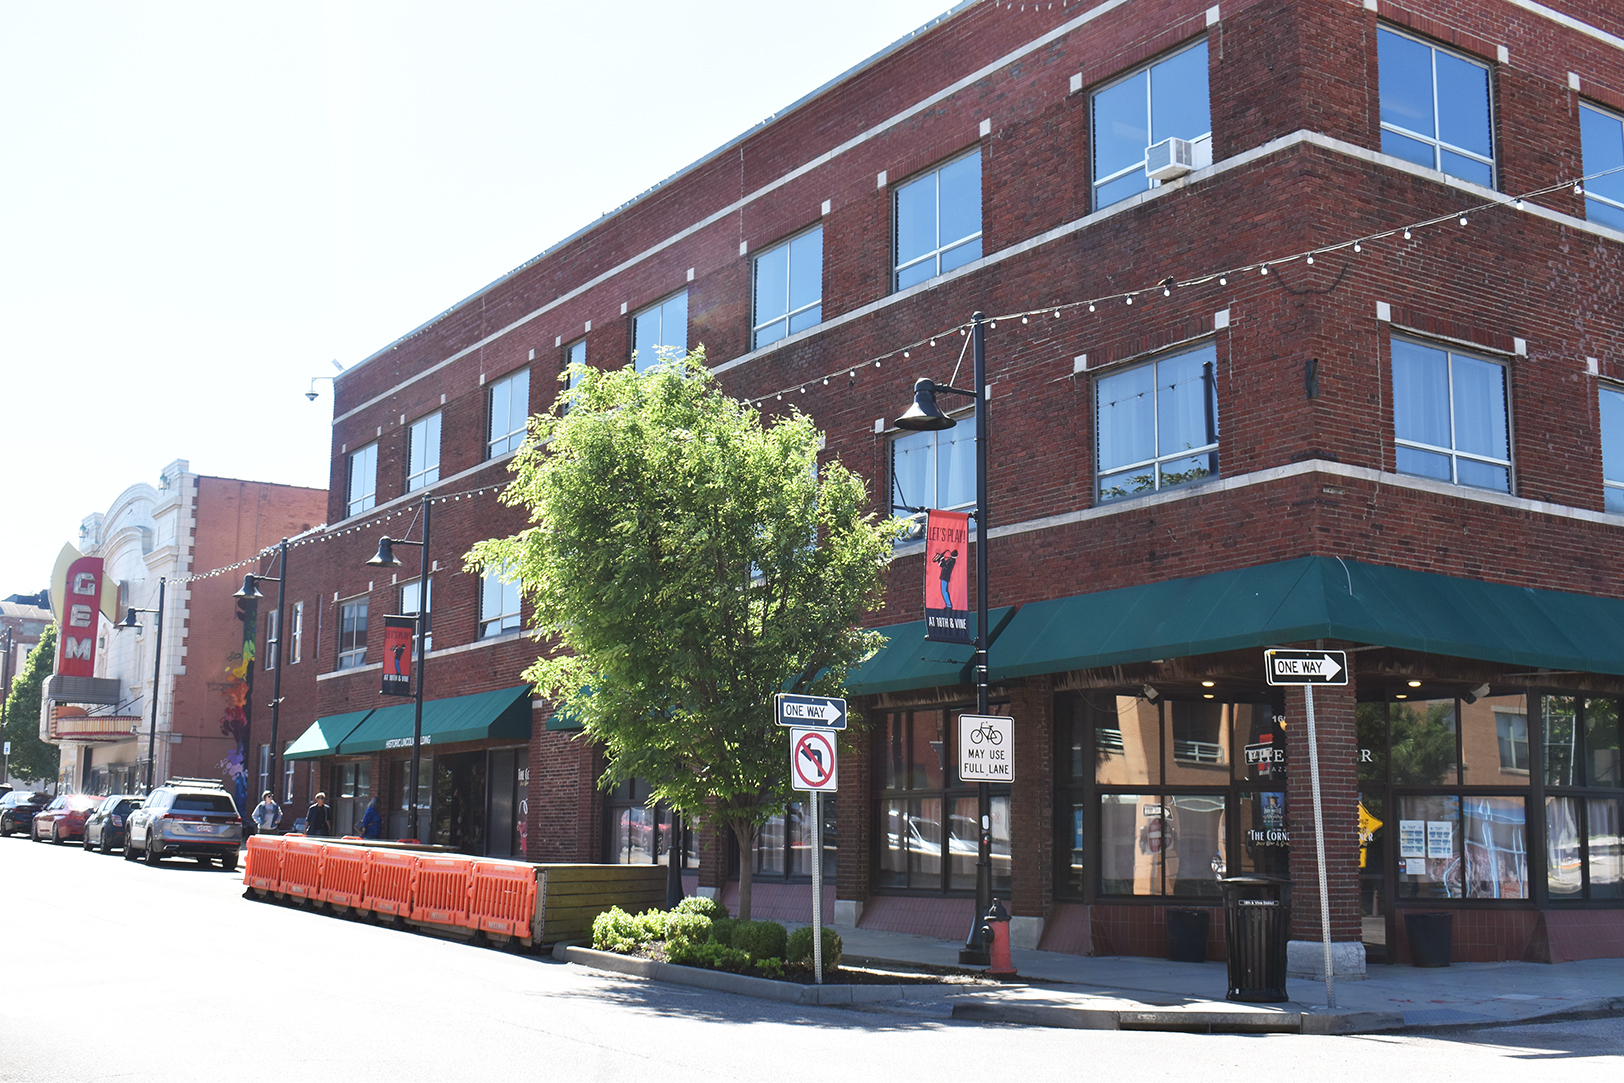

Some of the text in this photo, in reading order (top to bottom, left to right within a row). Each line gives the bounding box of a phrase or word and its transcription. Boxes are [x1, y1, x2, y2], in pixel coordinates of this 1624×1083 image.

[929, 527, 966, 544] LET'S PLAY!
[65, 572, 96, 661] GEM
[928, 616, 935, 627] AT
[949, 618, 955, 629] &
[955, 619, 967, 630] VINE
[1277, 660, 1323, 674] ONE WAY
[785, 704, 826, 718] ONE WAY
[968, 749, 1005, 760] MAY USE
[964, 763, 1009, 774] FULL LANE
